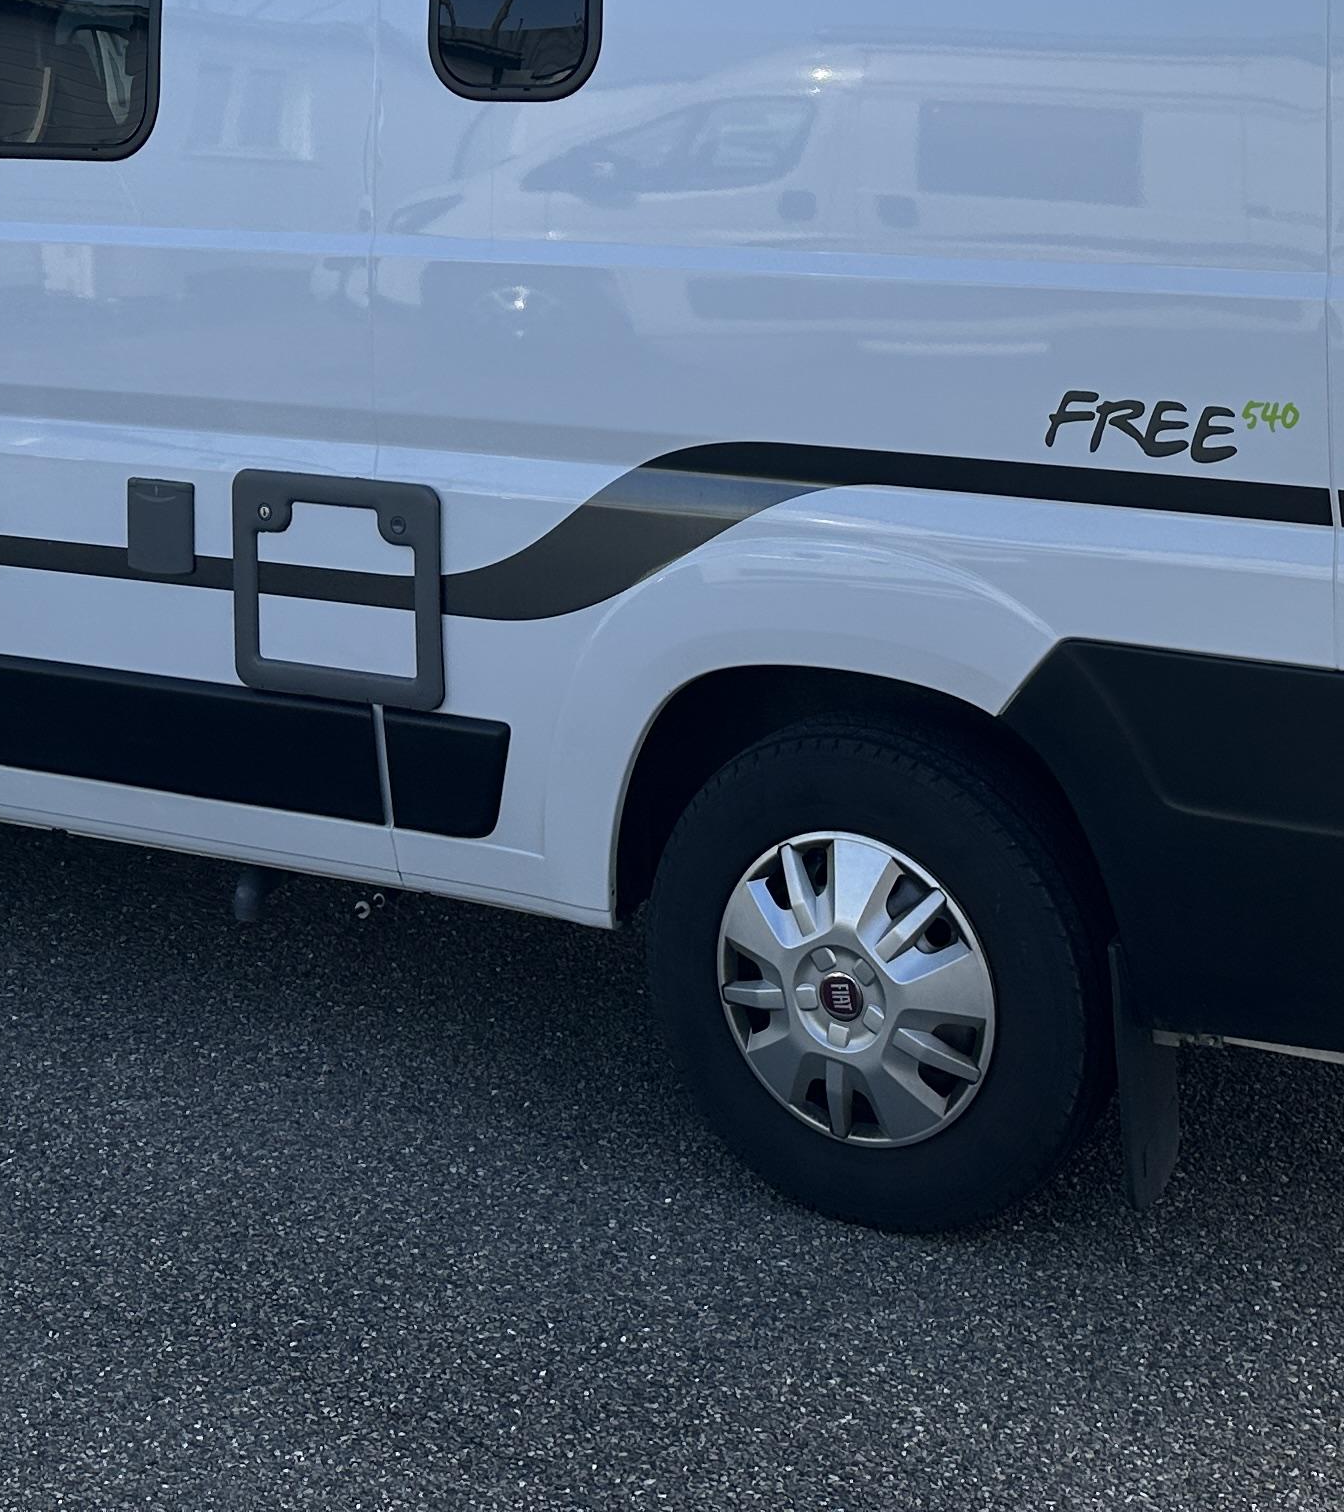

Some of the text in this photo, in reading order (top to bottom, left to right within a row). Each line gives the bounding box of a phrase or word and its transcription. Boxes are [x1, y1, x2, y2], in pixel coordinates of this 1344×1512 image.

[1045, 390, 1300, 464] FREE 540
[830, 983, 853, 1011] FIAT
